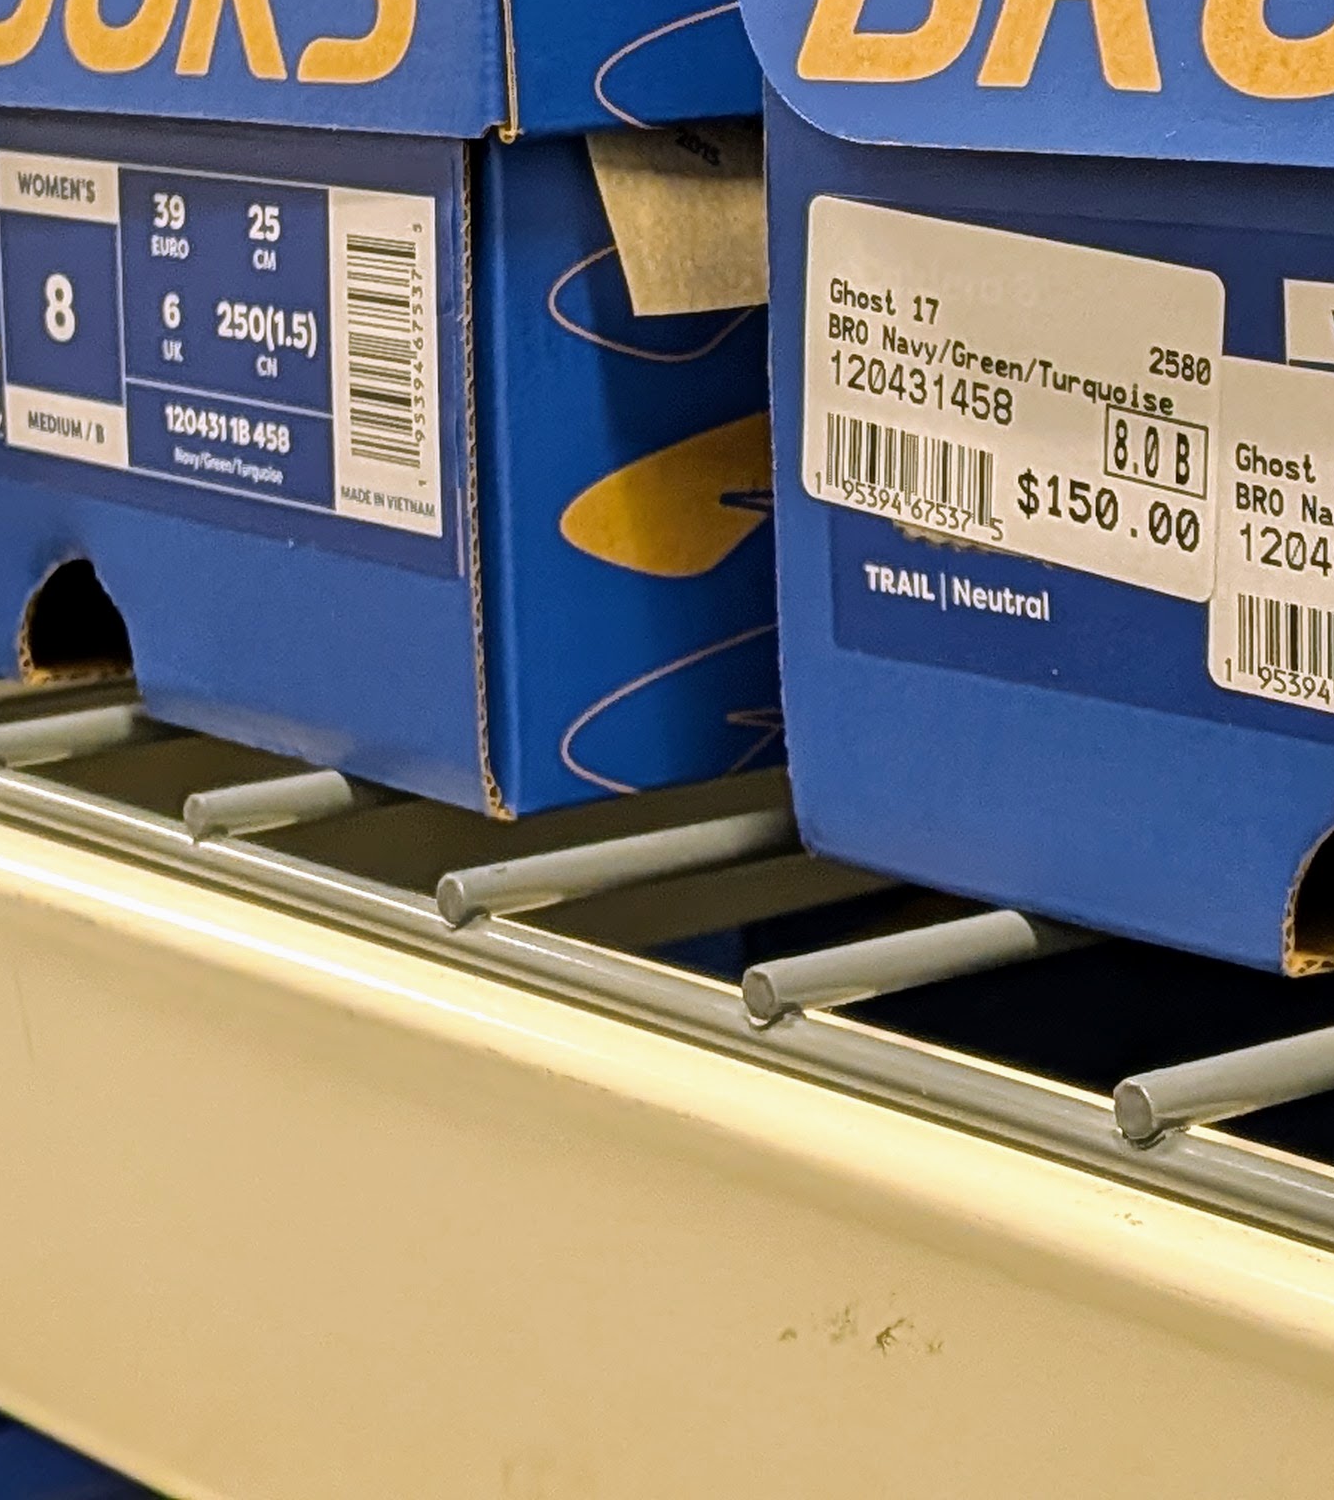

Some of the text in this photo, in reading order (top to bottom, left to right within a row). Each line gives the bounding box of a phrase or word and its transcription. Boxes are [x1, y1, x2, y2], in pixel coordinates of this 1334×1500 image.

[17, 171, 96, 204] WOMEN'S
[153, 192, 281, 243] 39 25
[151, 234, 277, 272] EURO CM
[45, 273, 76, 343] 8
[162, 292, 317, 359] 6 250(1.5)
[830, 277, 940, 326] Ghost 17
[162, 338, 183, 362] UK
[828, 313, 1175, 417] BRO Navy/Green/Turquoise
[1149, 346, 1211, 386] 2580
[830, 349, 1014, 427] 120431458
[28, 410, 83, 441] MEDIUM
[96, 423, 105, 445] B
[165, 404, 227, 443] 120431
[252, 421, 290, 455] 458
[1114, 418, 1190, 486] 8.0 B
[1234, 442, 1317, 485] Ghost
[340, 485, 436, 518] MADE IN VIETNAM
[842, 479, 902, 517] 95394
[910, 497, 972, 534] 67537
[991, 518, 1004, 542] 5
[1017, 467, 1200, 554] $150.00
[1235, 481, 1284, 518] BRO
[864, 563, 1050, 622] TRAIL Neutral
[1257, 665, 1331, 706] 95394
